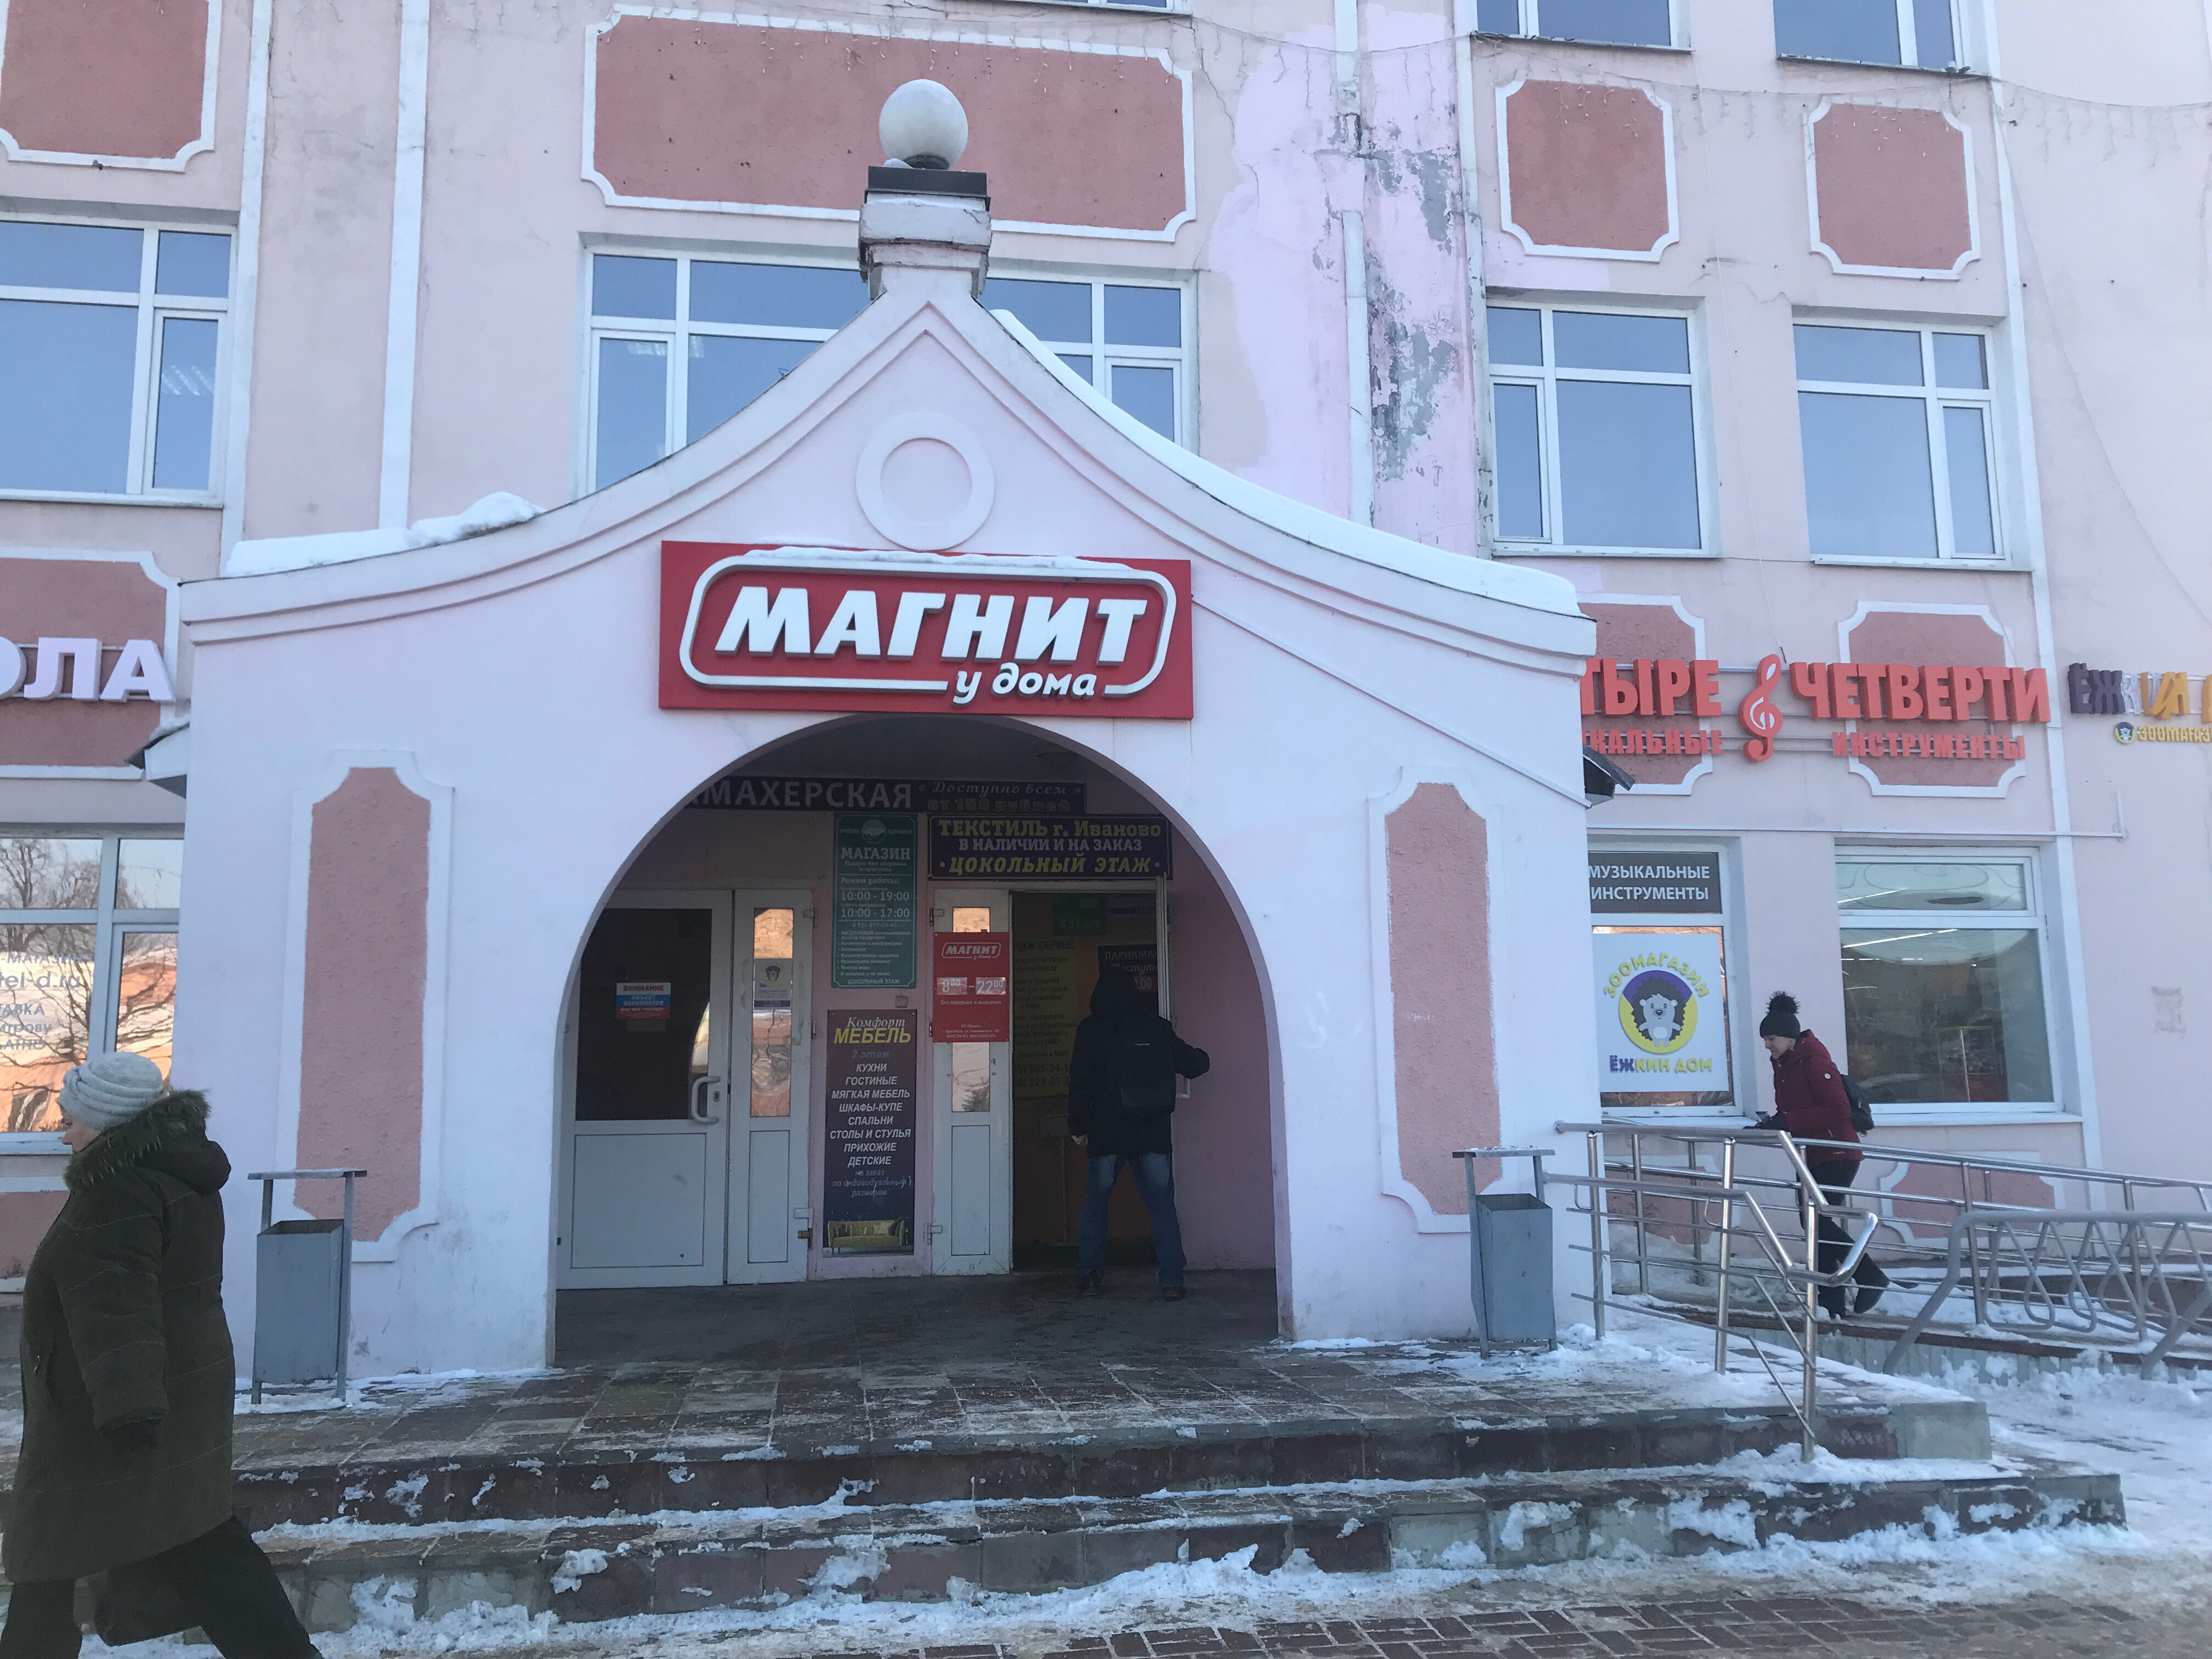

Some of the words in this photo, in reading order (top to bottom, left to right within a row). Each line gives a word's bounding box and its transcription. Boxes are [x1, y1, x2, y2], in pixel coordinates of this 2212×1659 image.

[715, 585, 1148, 667] МАГНИТ
[952, 670, 983, 707] у
[991, 662, 1097, 699] дома
[1788, 661, 2051, 724] ЧЕТВЕРТИ
[1582, 728, 1725, 755] КАЛЬНЫЕ
[1832, 731, 2025, 760] ИНСТРУМЕНТЫ
[938, 820, 1047, 837] ТЕКСТИЛЬ
[1053, 824, 1069, 837] г.
[1074, 820, 1162, 837] Иваново
[958, 839, 969, 851] В
[973, 839, 1049, 851] НАЛИЧИИ
[1053, 840, 1065, 851] И
[1068, 840, 1090, 851] НА
[1093, 839, 1143, 852] ЗАКАЗ
[840, 847, 911, 860] МАГАЗИН
[949, 853, 1086, 876] ЦОКОЛЬНЫЙ
[1094, 857, 1151, 873] ЭТАЖ
[1588, 865, 1710, 879] МУЗЫКАЛЬНЫЕ
[868, 877, 900, 885] работы:
[841, 891, 871, 901] 10:00
[880, 891, 910, 901] 19:00
[1590, 887, 1709, 900] ИНСТРУМЕНТЫ
[841, 908, 871, 917] 10:00
[880, 908, 910, 917] 17:00
[946, 945, 998, 955] МАГНИТ
[1604, 952, 1710, 998] ЗООМАГАЗИН
[847, 1017, 905, 1029] Комфорт
[833, 1027, 911, 1044] МЕБЕЛЬ
[851, 1049, 858, 1058] 2
[856, 1063, 888, 1073] КУХНИ
[1609, 1054, 1670, 1073] ЁЖКИН
[1675, 1058, 1712, 1073] ДОМ
[845, 1076, 898, 1086] ГОСТИНЫЕ
[831, 1090, 870, 1099] МЯГКАЯ
[872, 1089, 910, 1098] МЕБЕЛЬ
[839, 1102, 903, 1113] ШКАФЫ-КУПЕ
[848, 1116, 894, 1126] СПАЛЬНИ
[830, 1130, 864, 1139] СТОЛЫ
[866, 1130, 873, 1138] И
[874, 1128, 911, 1138] СТУЛЬЯ
[844, 1142, 897, 1152] ПРИХОЖИЕ
[848, 1155, 892, 1168] ДЕТСКИЕ
